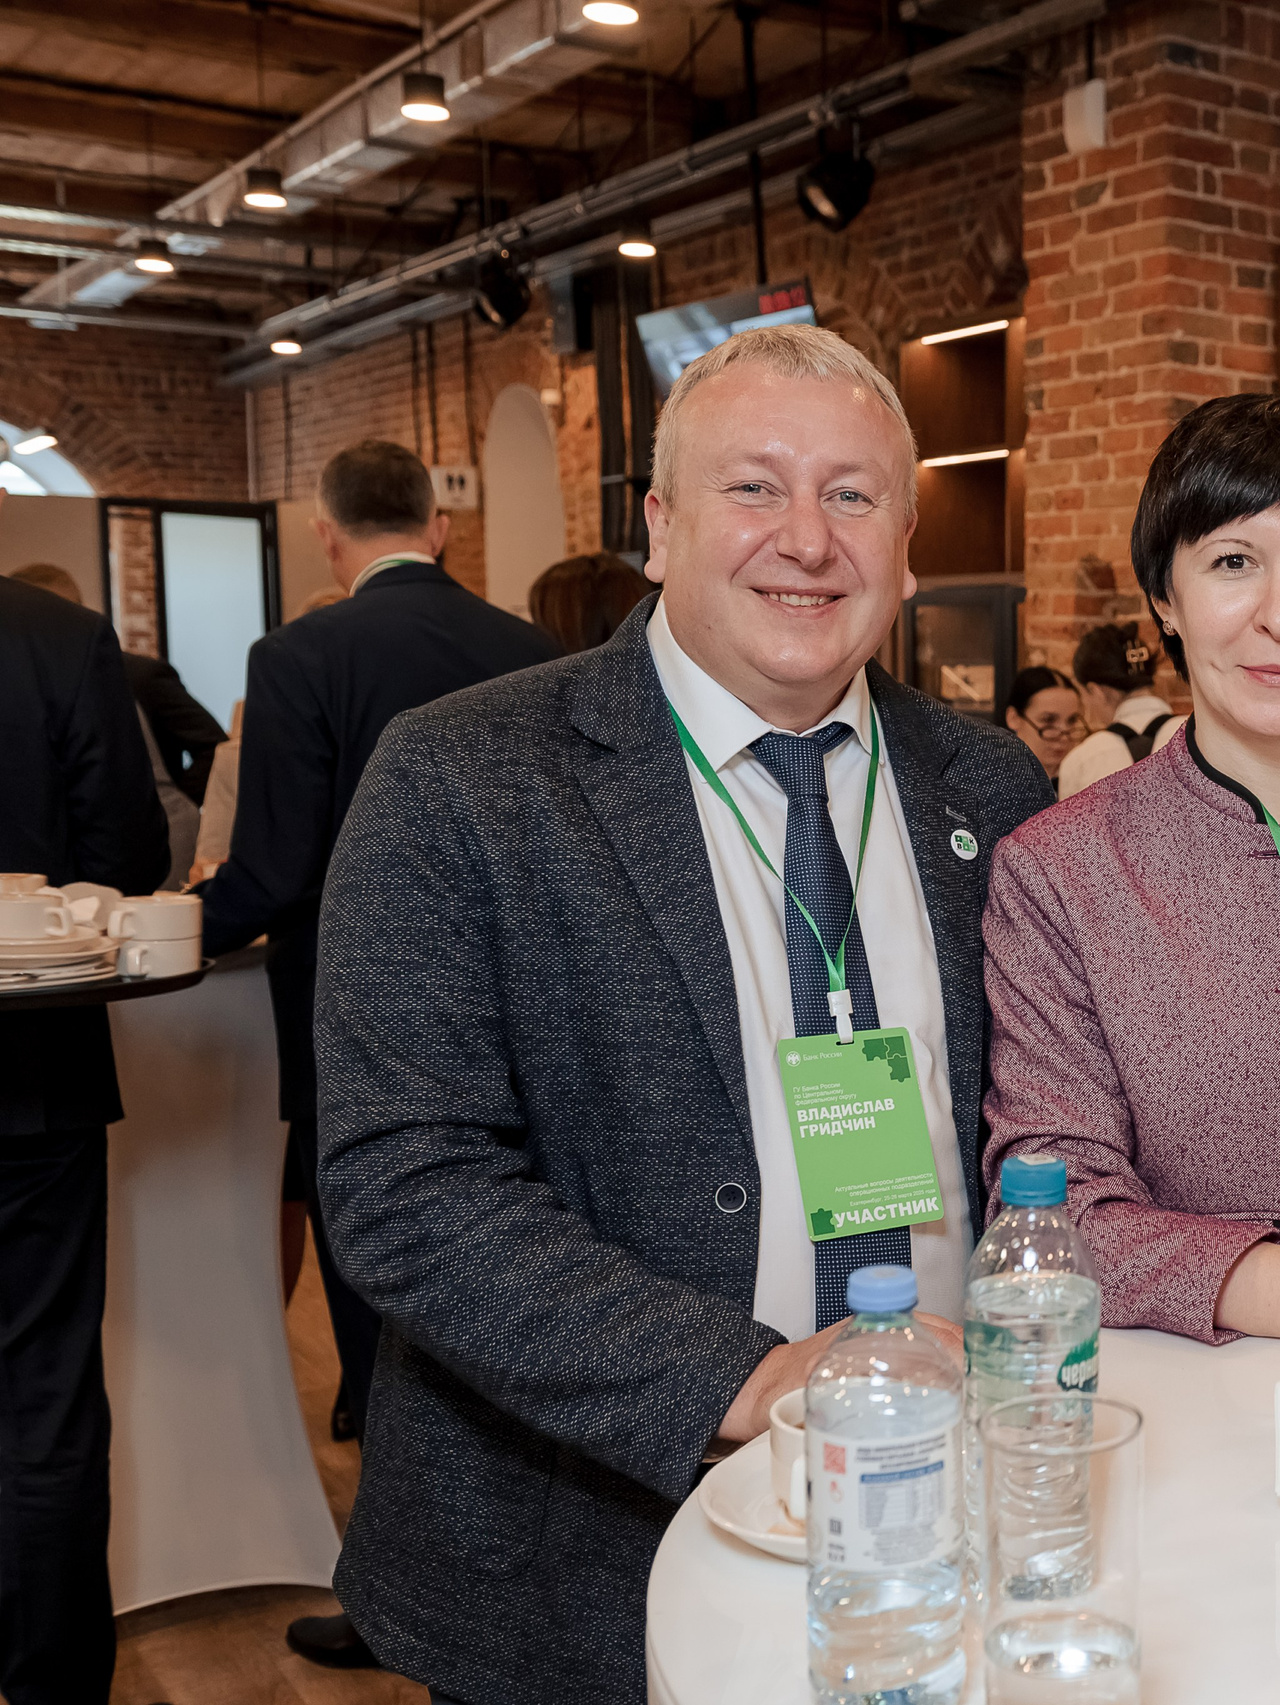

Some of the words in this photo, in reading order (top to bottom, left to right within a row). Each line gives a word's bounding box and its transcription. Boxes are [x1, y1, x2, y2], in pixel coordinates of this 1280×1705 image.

[796, 1098, 895, 1123] ВЛАДИСЛАВ
[799, 1116, 876, 1139] ГРИДЧИН
[834, 1196, 940, 1228] УЧАСТНИК
